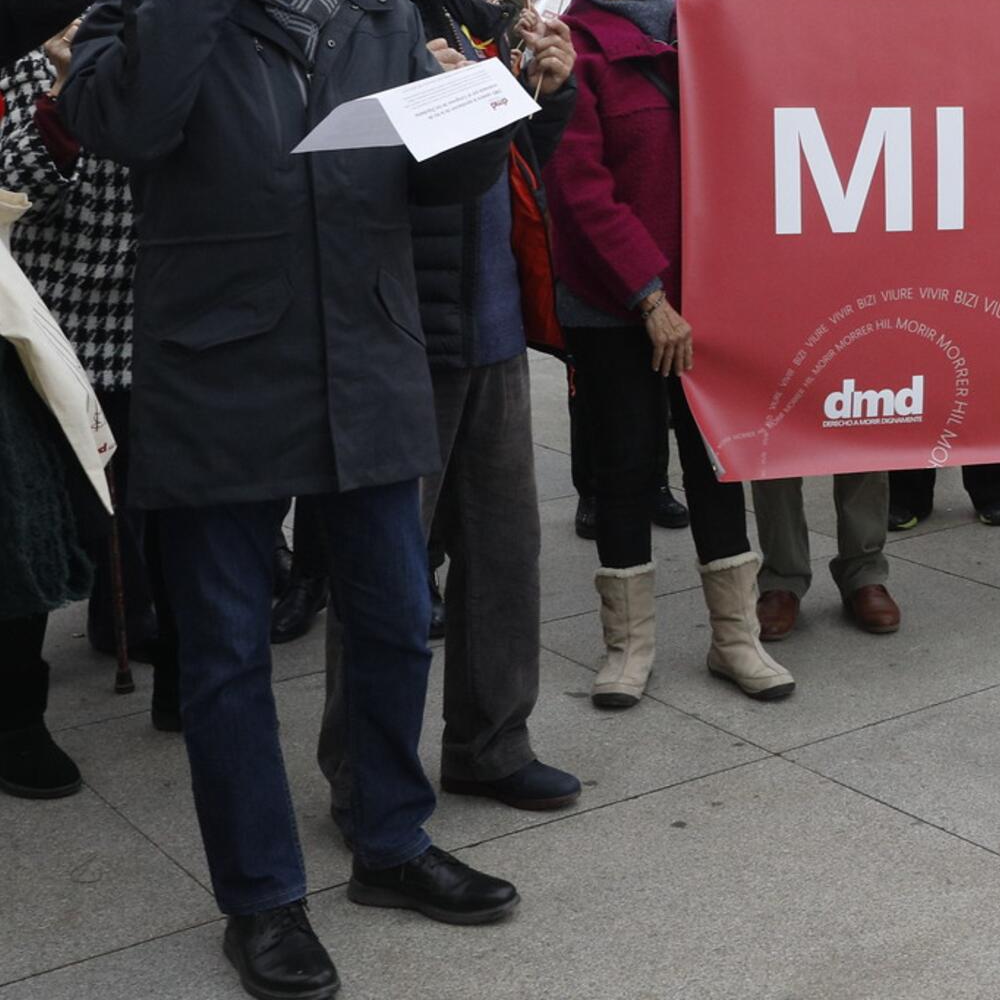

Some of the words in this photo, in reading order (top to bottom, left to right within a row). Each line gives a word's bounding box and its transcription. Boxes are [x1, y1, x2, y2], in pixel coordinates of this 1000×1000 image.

[774, 106, 966, 235] MI
[828, 304, 855, 325] VIVIR
[856, 294, 877, 310] BIZI
[881, 287, 913, 302] VIURE
[919, 287, 950, 301] VIVIR
[954, 289, 979, 309] BIZI
[834, 322, 874, 353] MORRER
[875, 318, 893, 331] HIL
[895, 317, 937, 342] MORIR
[935, 334, 970, 398] MORRER
[823, 374, 925, 420] dmd
[945, 400, 969, 425] HIL
